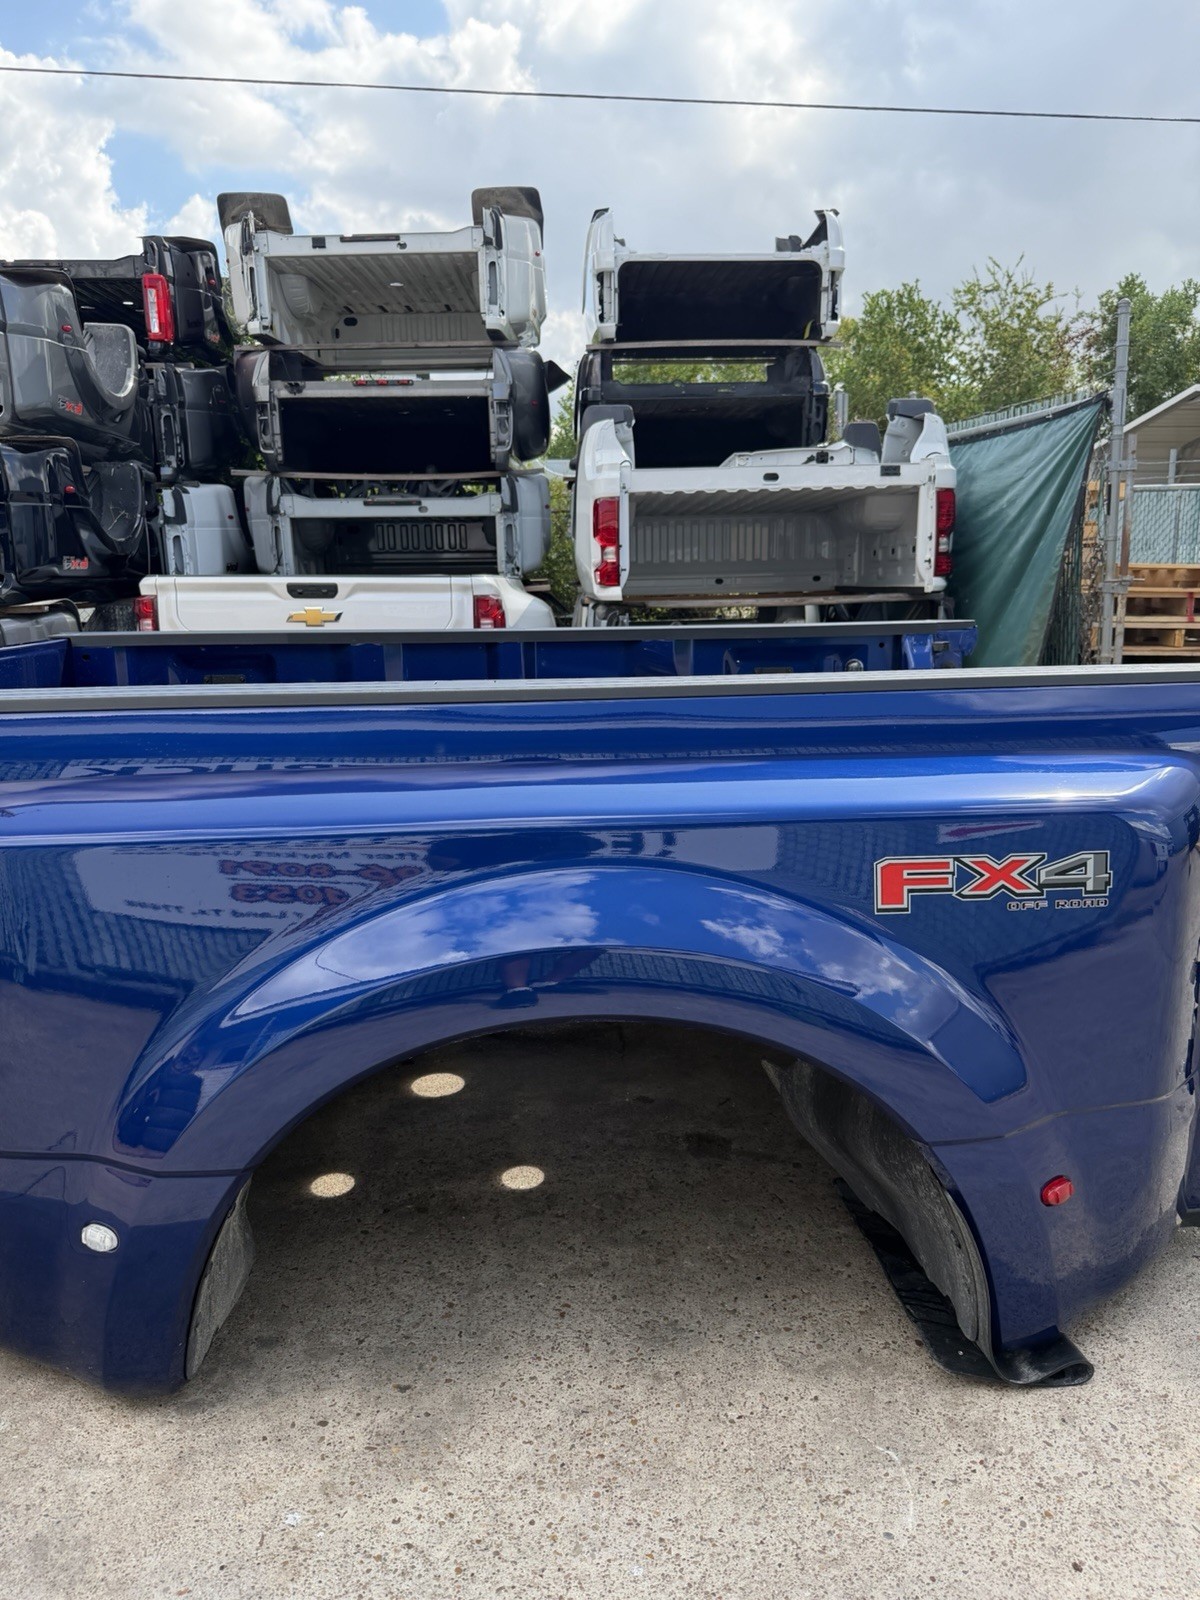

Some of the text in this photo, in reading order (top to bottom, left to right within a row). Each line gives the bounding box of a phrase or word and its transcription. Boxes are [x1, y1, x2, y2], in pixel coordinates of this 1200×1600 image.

[874, 850, 1112, 914] FX4
[1006, 898, 1109, 911] OFF ROAD
